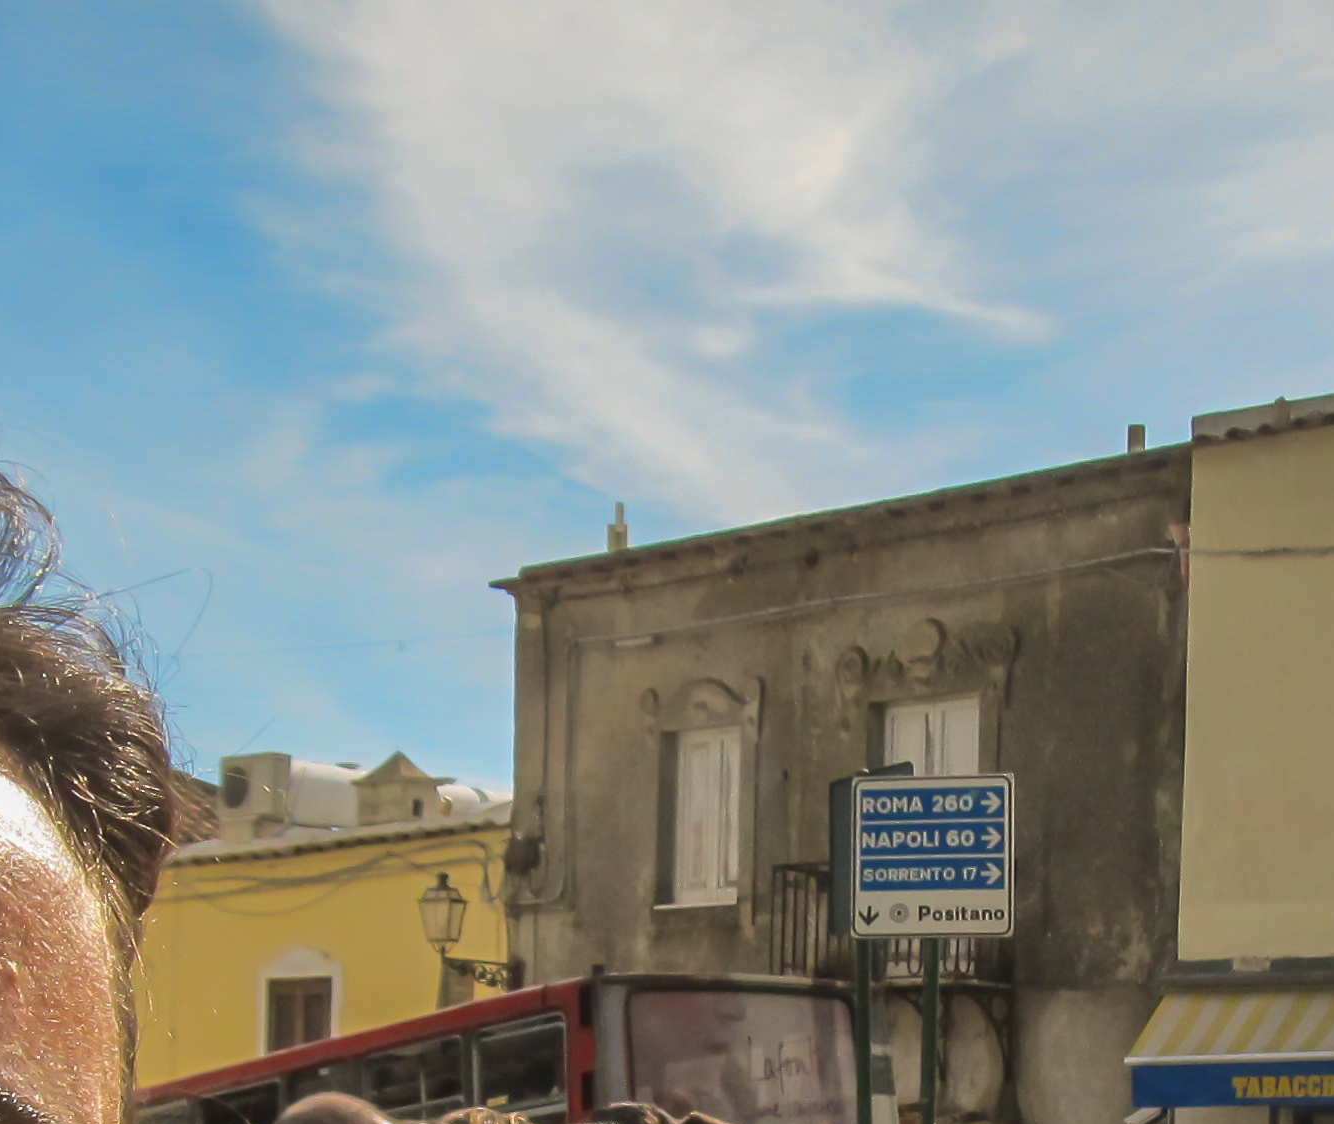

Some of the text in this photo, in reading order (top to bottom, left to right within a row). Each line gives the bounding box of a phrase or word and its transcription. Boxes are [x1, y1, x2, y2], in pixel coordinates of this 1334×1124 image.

[861, 794, 974, 814] ROMA 260
[861, 829, 976, 849] NAPOLI 60
[862, 865, 978, 882] SORRENTO 17
[917, 905, 1006, 922] Positano
